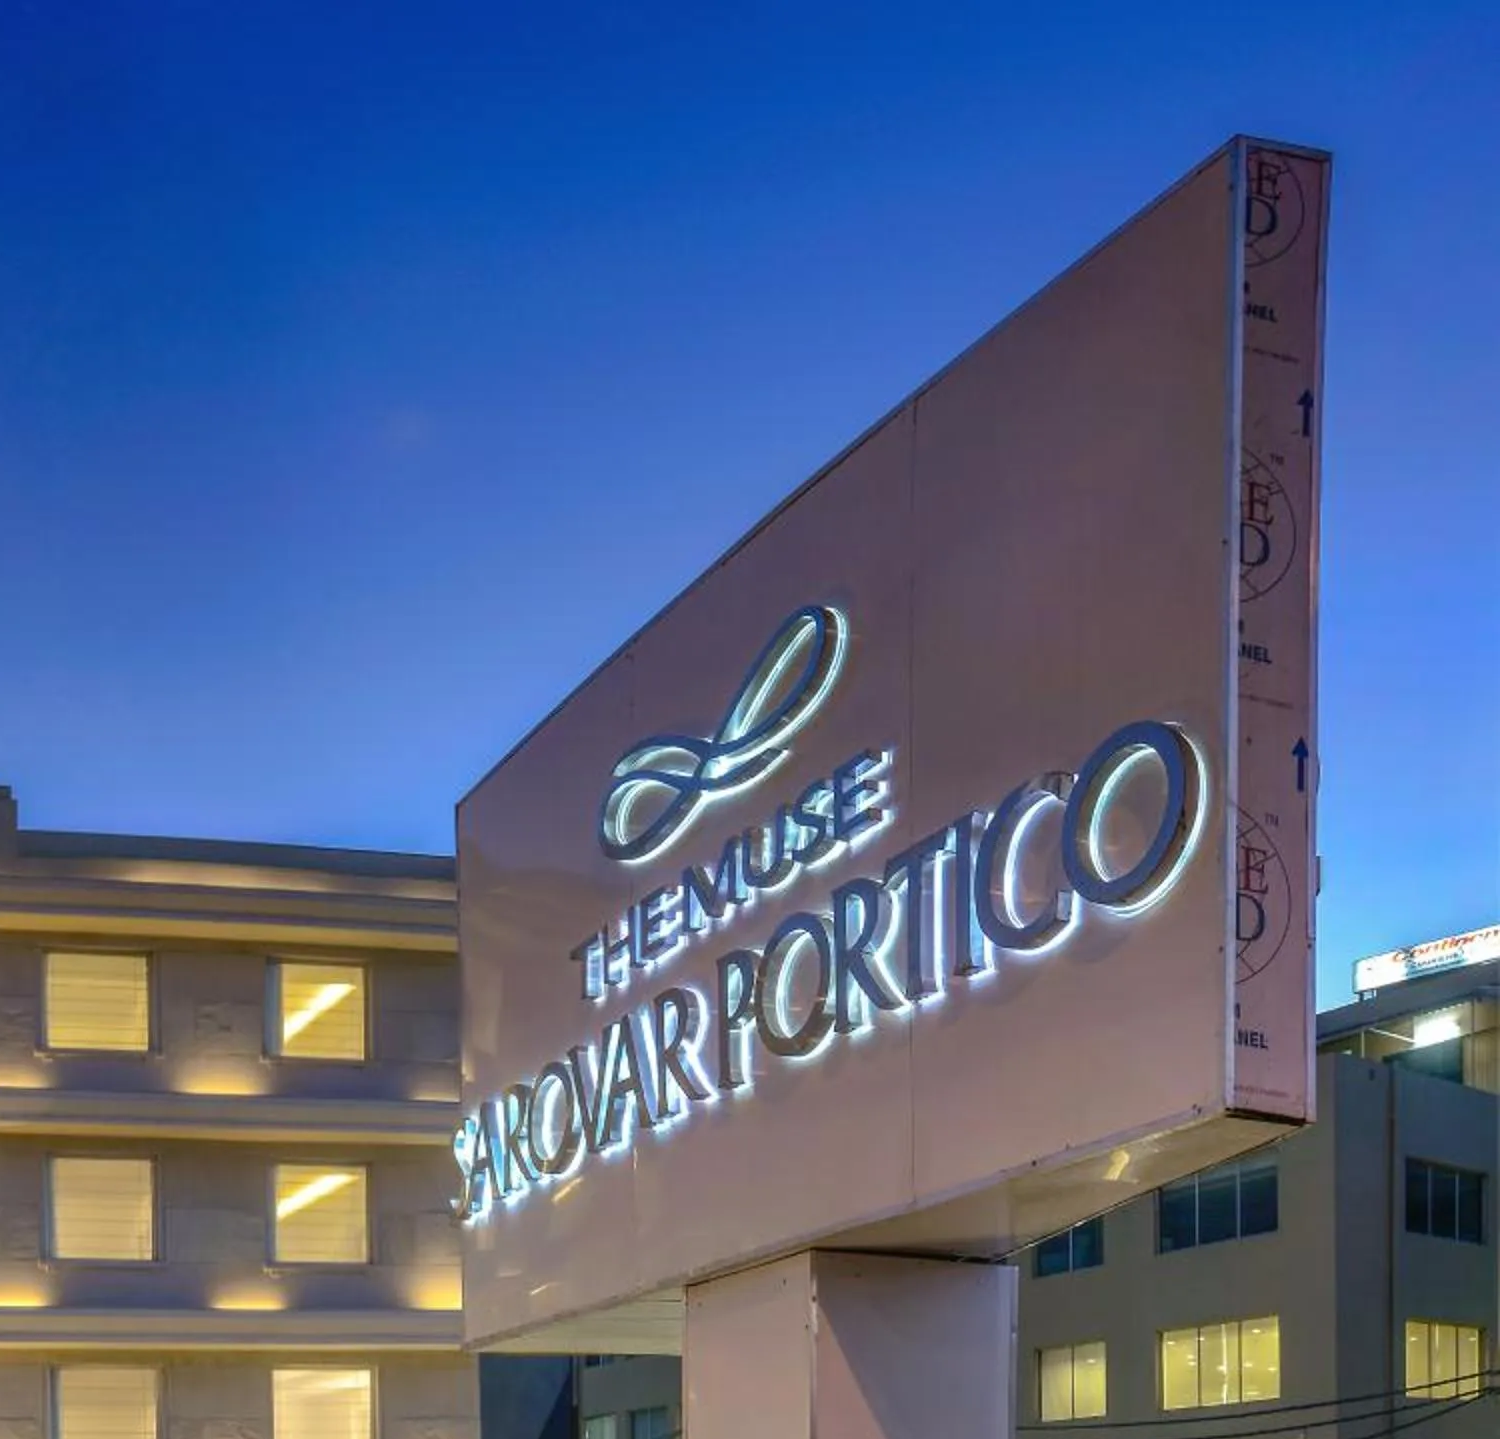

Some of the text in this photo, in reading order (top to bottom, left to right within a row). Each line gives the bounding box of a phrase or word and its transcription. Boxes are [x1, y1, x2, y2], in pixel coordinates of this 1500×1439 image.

[1238, 642, 1273, 665] NEL
[570, 748, 892, 1003] THE MUSE
[449, 719, 1207, 1226] SAROVAR PORTICO
[1234, 1028, 1269, 1050] NEL
